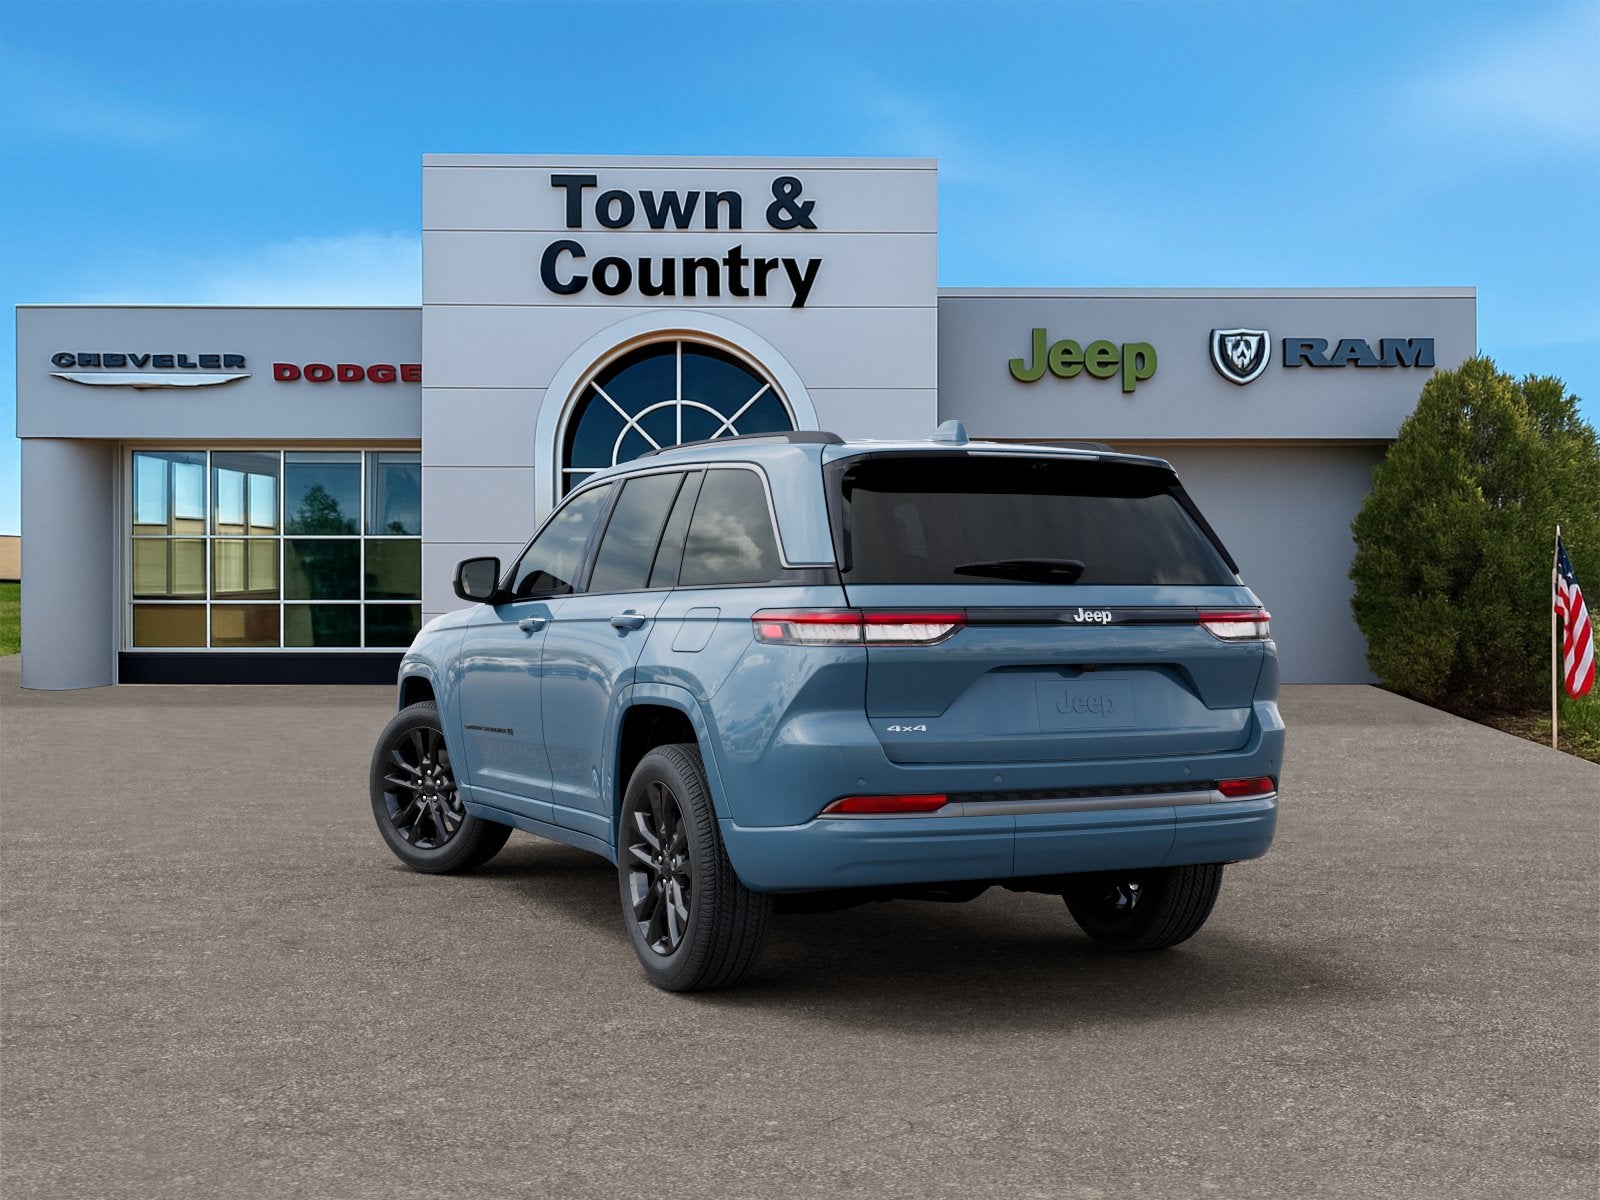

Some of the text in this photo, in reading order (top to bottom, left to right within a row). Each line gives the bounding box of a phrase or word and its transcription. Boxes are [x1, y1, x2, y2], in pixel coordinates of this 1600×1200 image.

[550, 174, 818, 230] Town &
[540, 239, 822, 308] Country
[1009, 328, 1158, 393] Jeep
[1283, 338, 1435, 367] RAM
[273, 363, 422, 383] DODGE
[1073, 607, 1112, 625] Jeep
[1055, 689, 1117, 718] Jeep
[886, 724, 927, 732] 4x4
